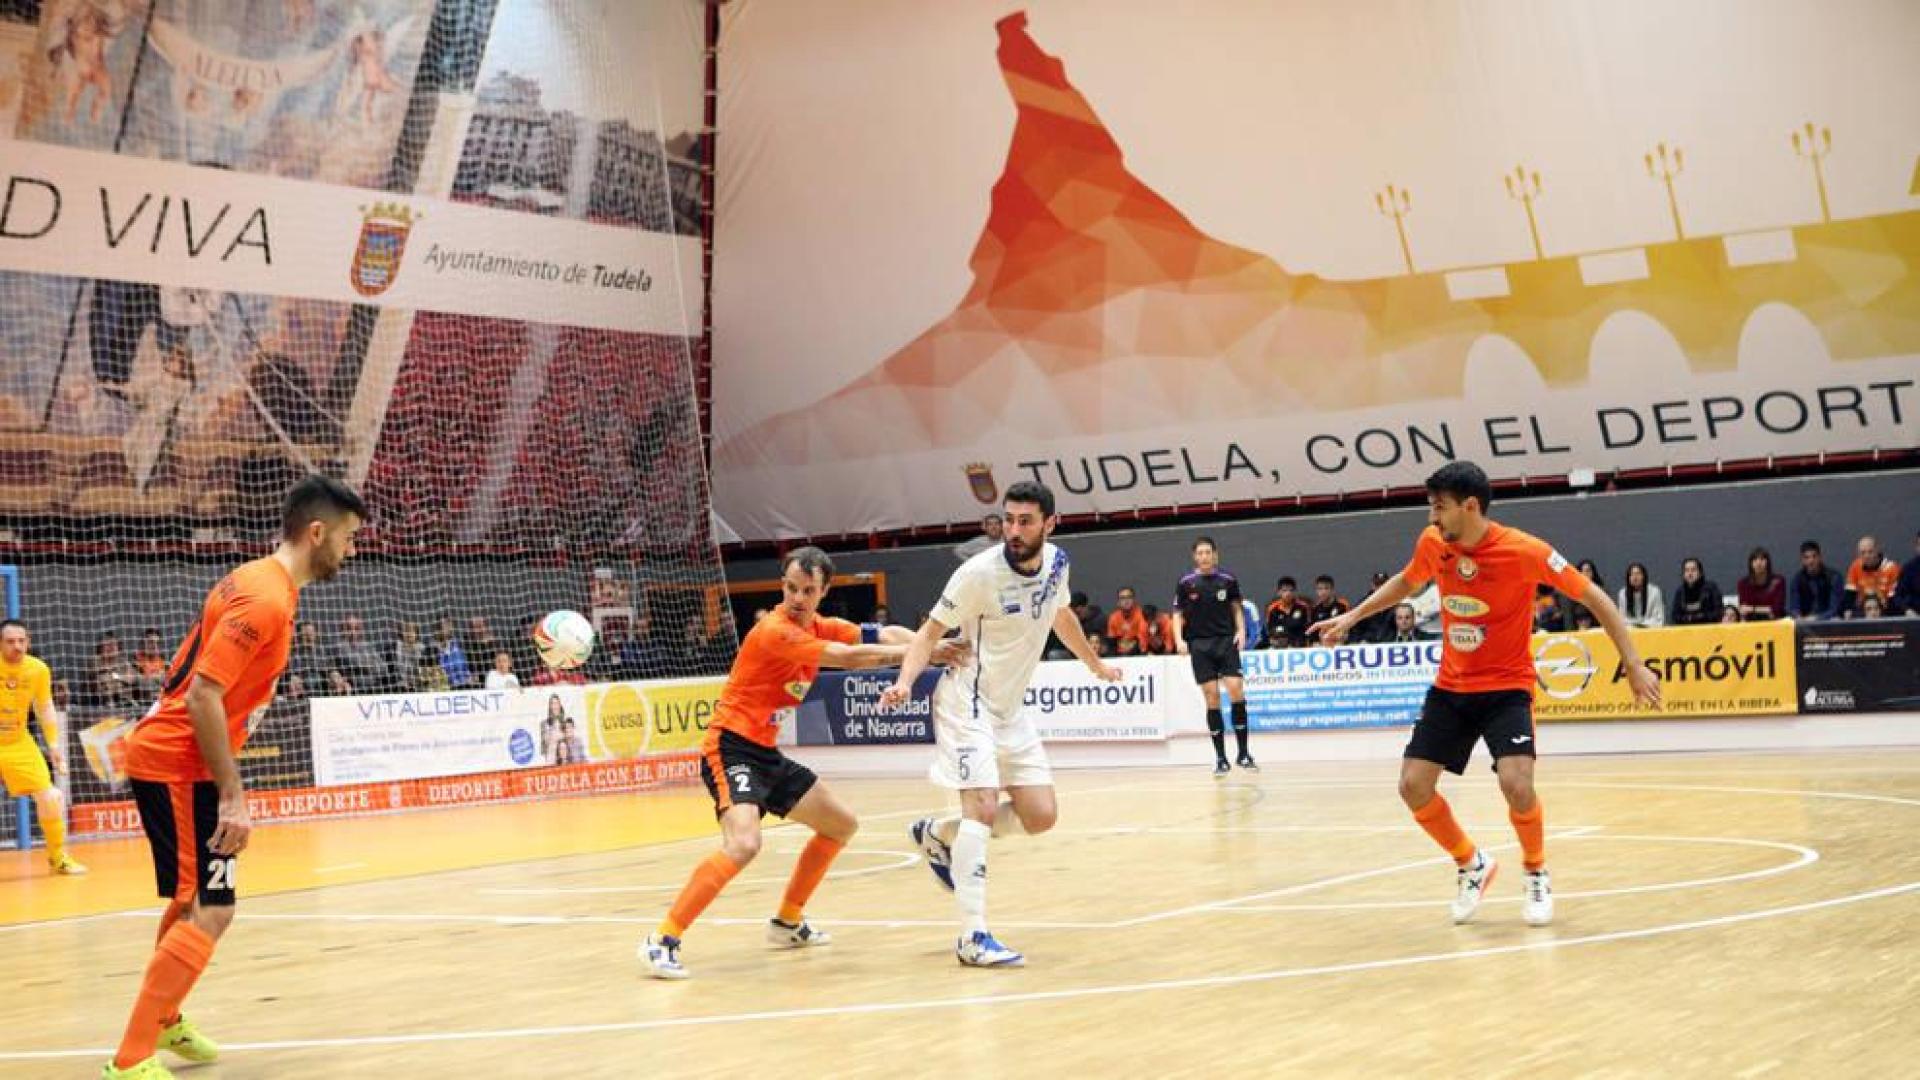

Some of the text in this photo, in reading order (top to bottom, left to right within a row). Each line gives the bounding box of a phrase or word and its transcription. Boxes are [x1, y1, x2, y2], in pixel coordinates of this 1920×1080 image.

[100, 187, 272, 264] VIVA
[423, 243, 653, 292] Ayuntamiento de Tudela
[1018, 380, 1914, 495] TUDELA, CON EL DEPORT
[1242, 646, 1441, 675] RUPORUBIO
[358, 693, 504, 721] VITALDENT
[845, 718, 926, 737] de Navarra
[428, 779, 503, 801] DEPORTE
[526, 772, 591, 793] TUDELA
[595, 765, 629, 788] CON
[633, 763, 653, 782] EL
[735, 773, 752, 792] 2
[249, 798, 272, 817] EL
[280, 789, 371, 815] DEPORTE
